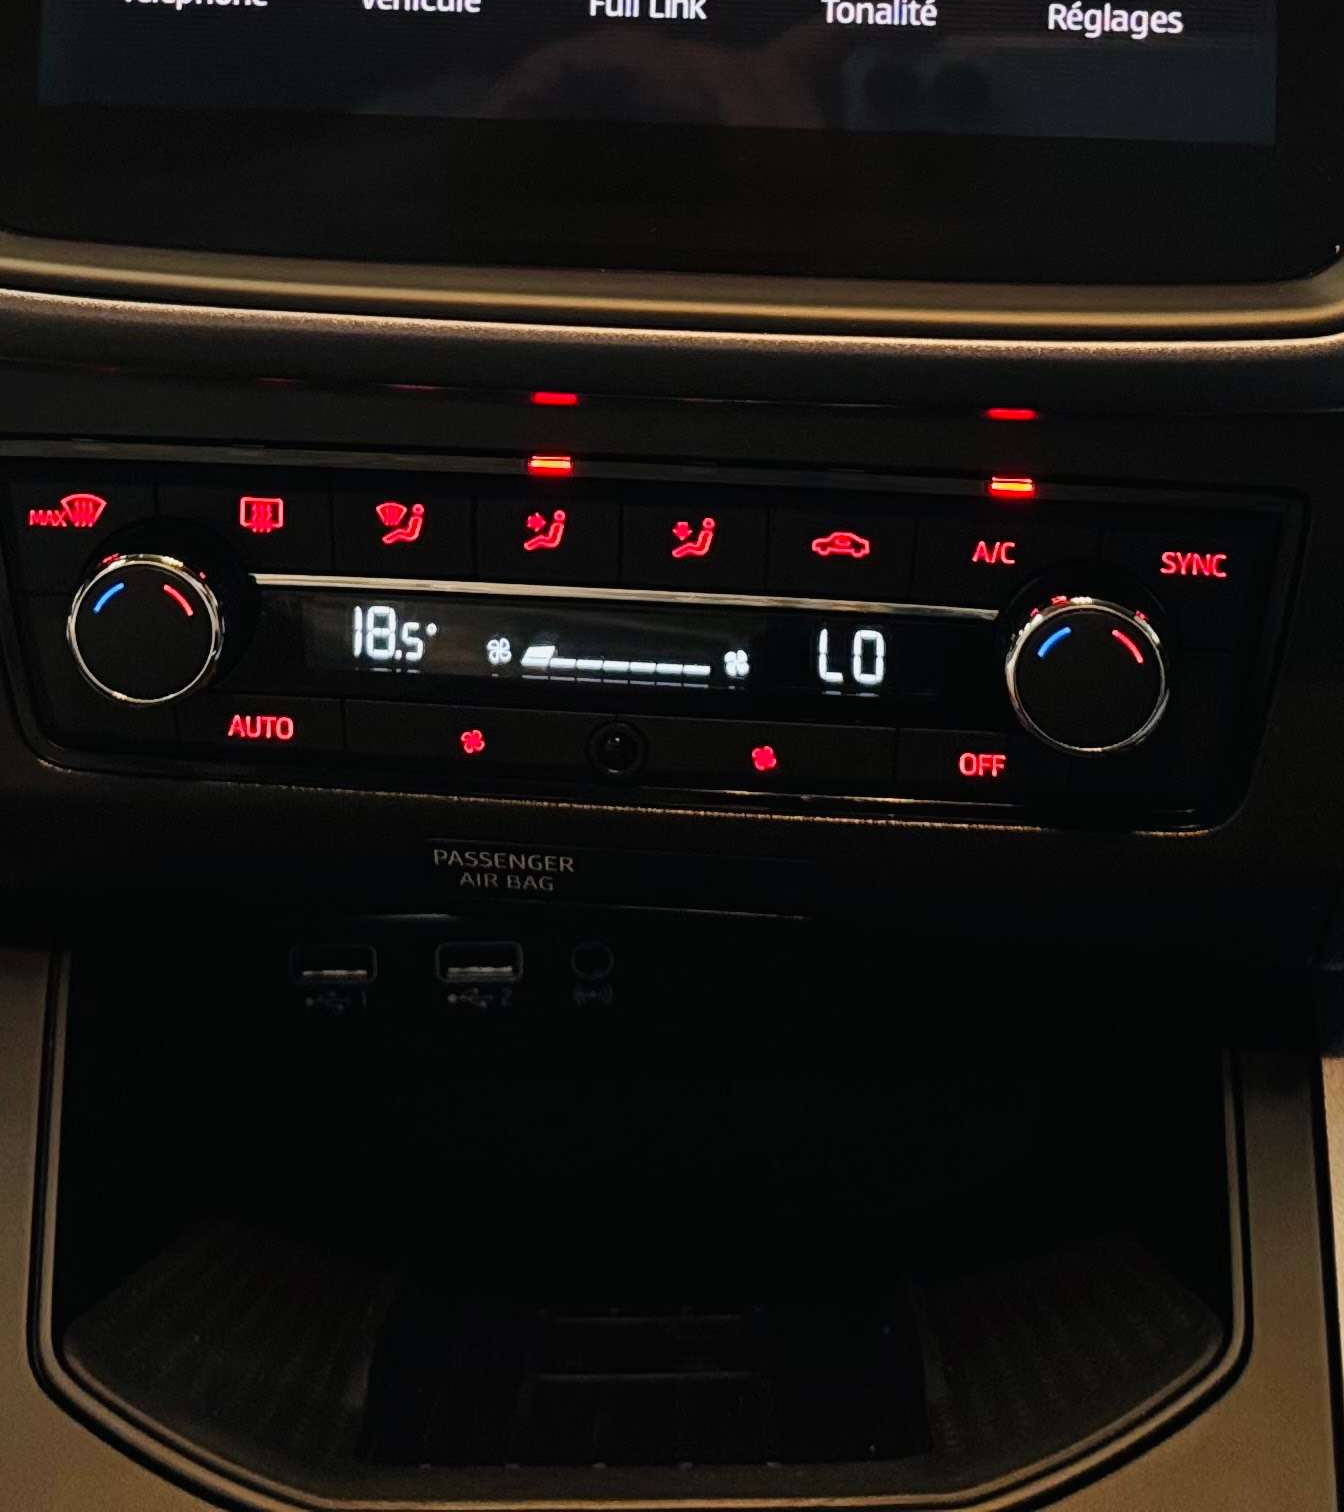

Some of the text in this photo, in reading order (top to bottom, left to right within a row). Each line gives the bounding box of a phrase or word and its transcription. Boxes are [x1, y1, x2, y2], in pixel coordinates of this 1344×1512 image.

[1048, 0, 1184, 40] Réglages
[29, 509, 67, 527] MAX
[972, 541, 1016, 565] A/C
[1160, 551, 1228, 578] SYNC
[818, 628, 886, 685] LO
[228, 714, 294, 740] AUTO
[959, 752, 1007, 777] OFF
[433, 848, 575, 873] PASSENGER
[460, 872, 554, 892] AIR BAG
